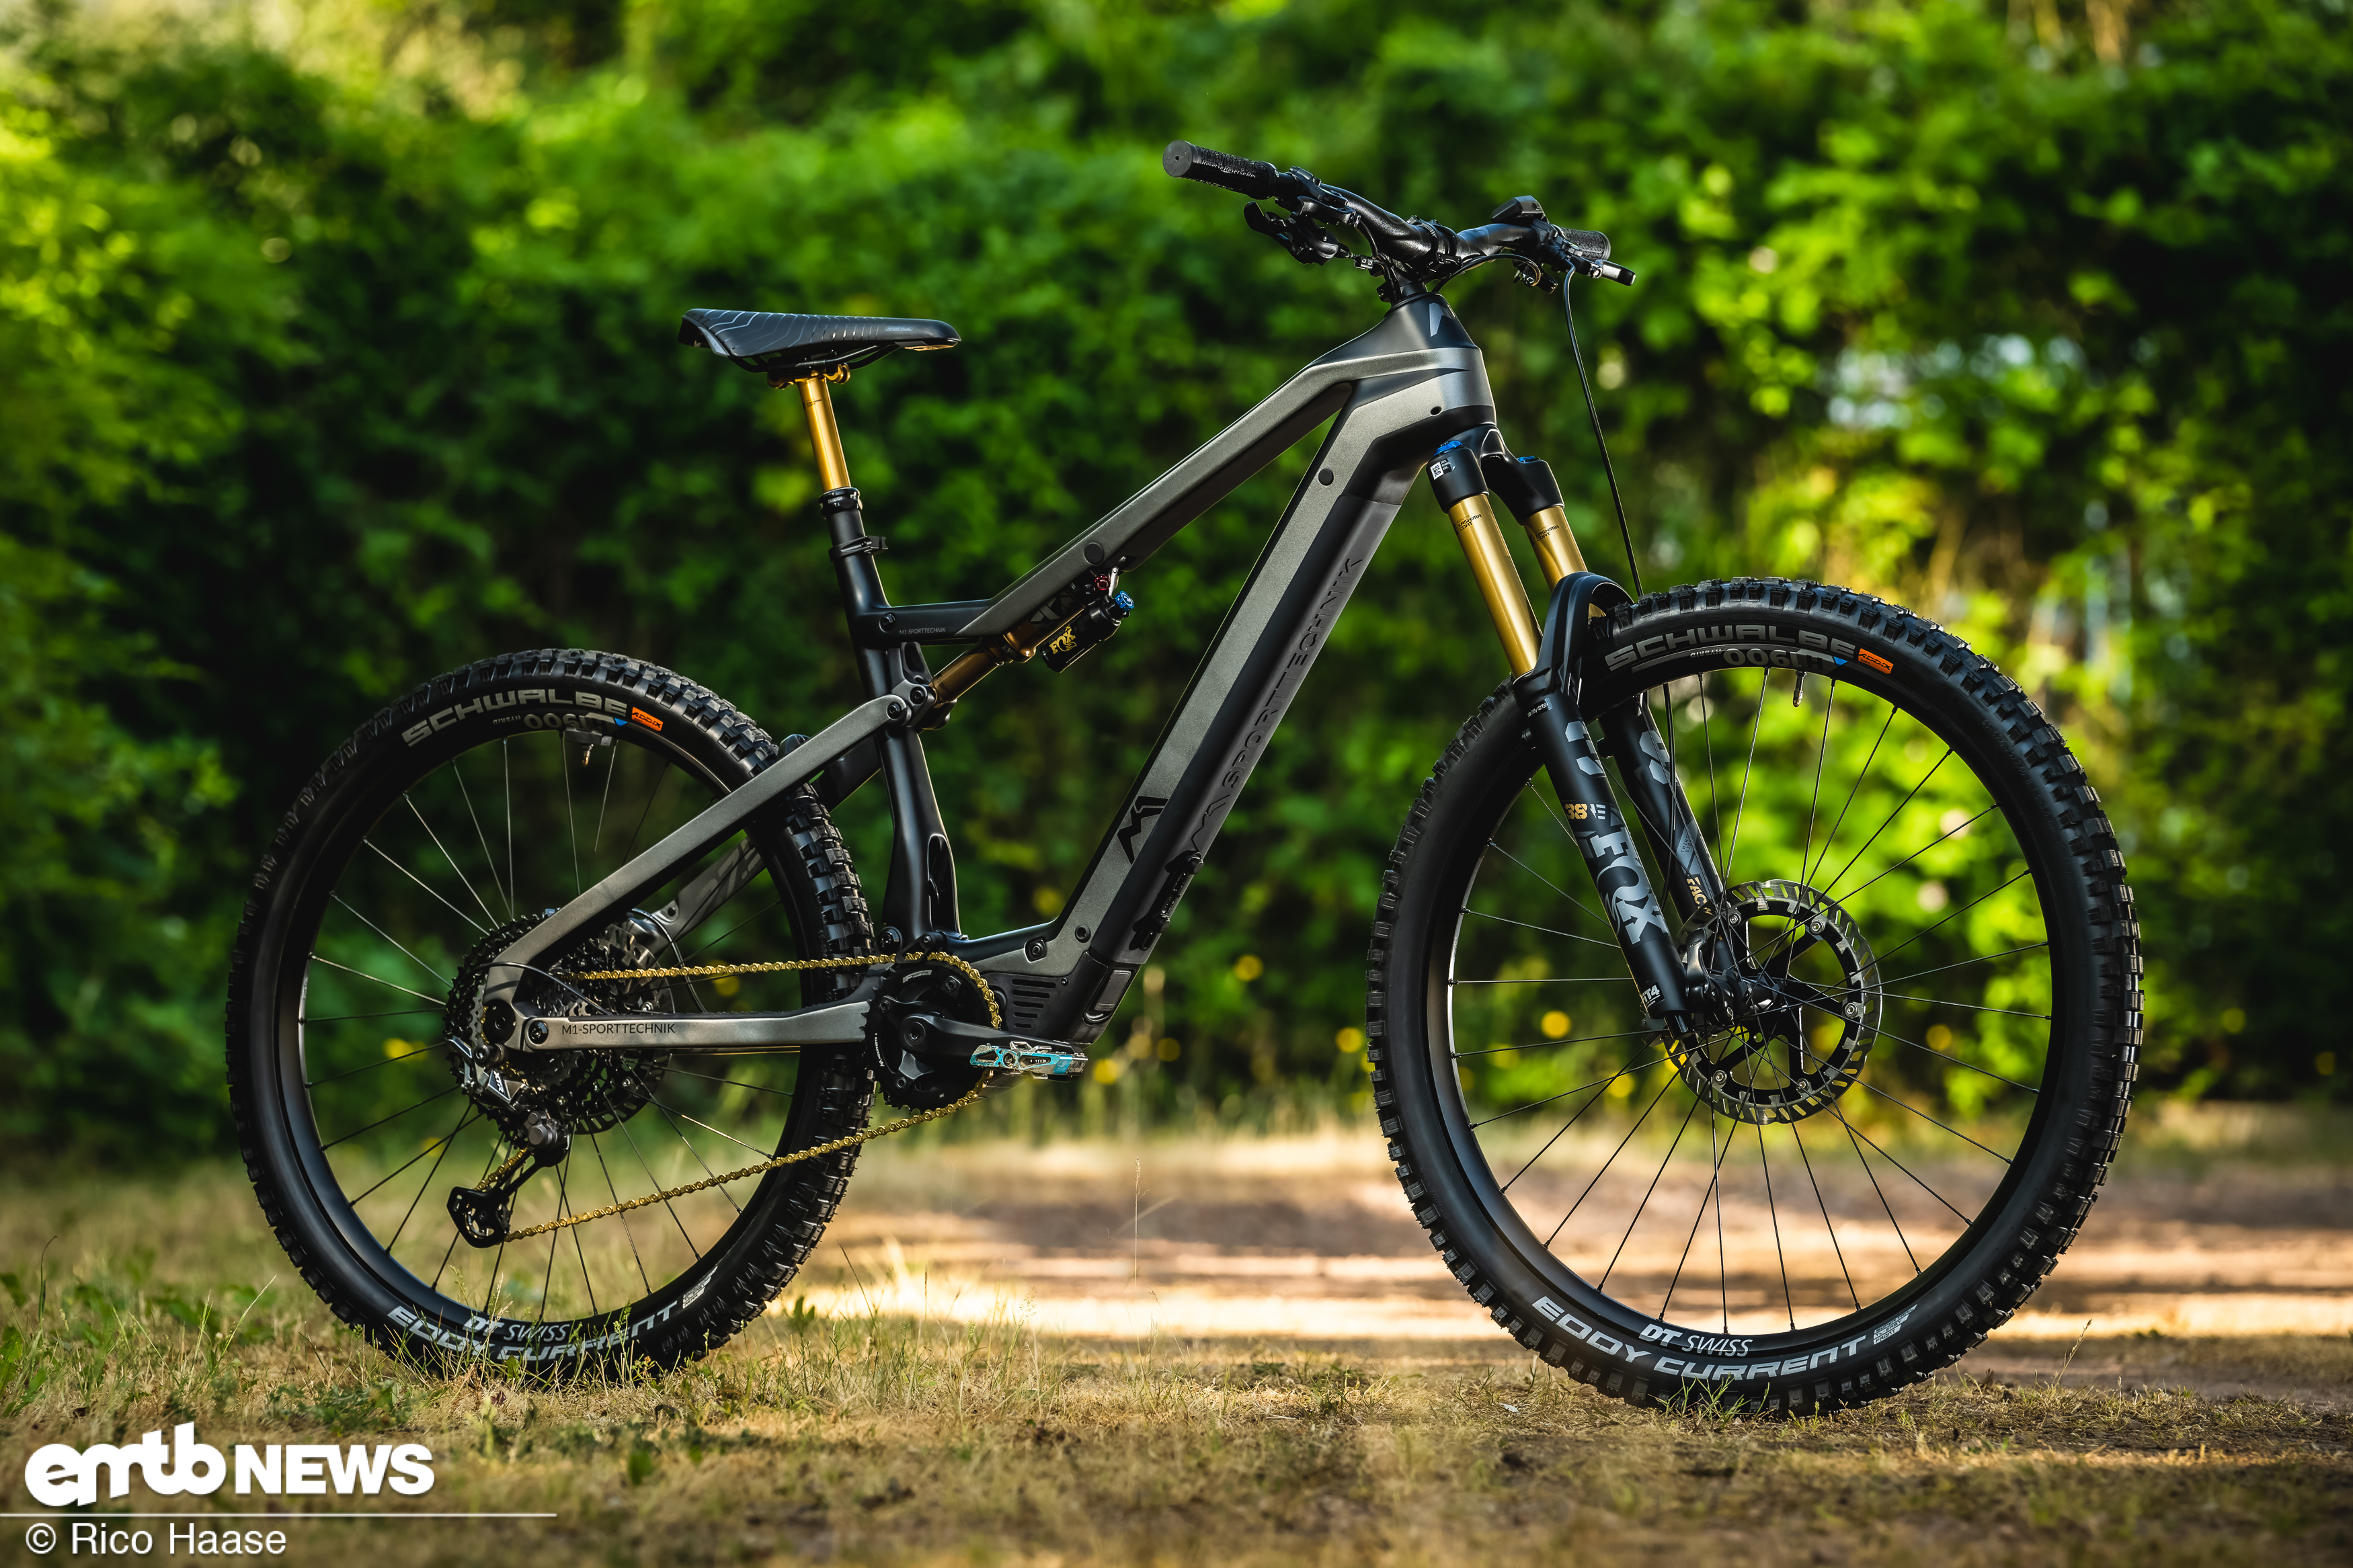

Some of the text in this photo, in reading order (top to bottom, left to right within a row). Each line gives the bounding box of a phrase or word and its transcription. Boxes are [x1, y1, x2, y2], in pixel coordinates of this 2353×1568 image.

[1458, 513, 1482, 528] KASHIMA
[1460, 522, 1473, 531] COAT
[1536, 525, 1559, 538] KASHIMA
[1537, 532, 1550, 541] COAT
[899, 626, 947, 636] M1-SPORTTECHNIK
[1049, 627, 1077, 655] FOX
[1605, 625, 1856, 671] SCHWALBE
[1690, 649, 1722, 658] HYBRID
[1222, 558, 1363, 788] SPORTTECHNIK
[401, 688, 627, 747] SCHWALBE
[493, 714, 522, 725] HYBRID
[1564, 803, 1588, 819] 38
[1590, 826, 1670, 945] FOX
[561, 1022, 676, 1035] M1-SPORTTECHNIK
[493, 1071, 505, 1094] XTR
[388, 1301, 677, 1361] EDDY CURRENT
[463, 1317, 570, 1343] DT SWISS
[1532, 1295, 1866, 1380] EDDY CURRENT
[1875, 1329, 1897, 1344] FRONT
[1638, 1323, 1753, 1357] DT SWISS
